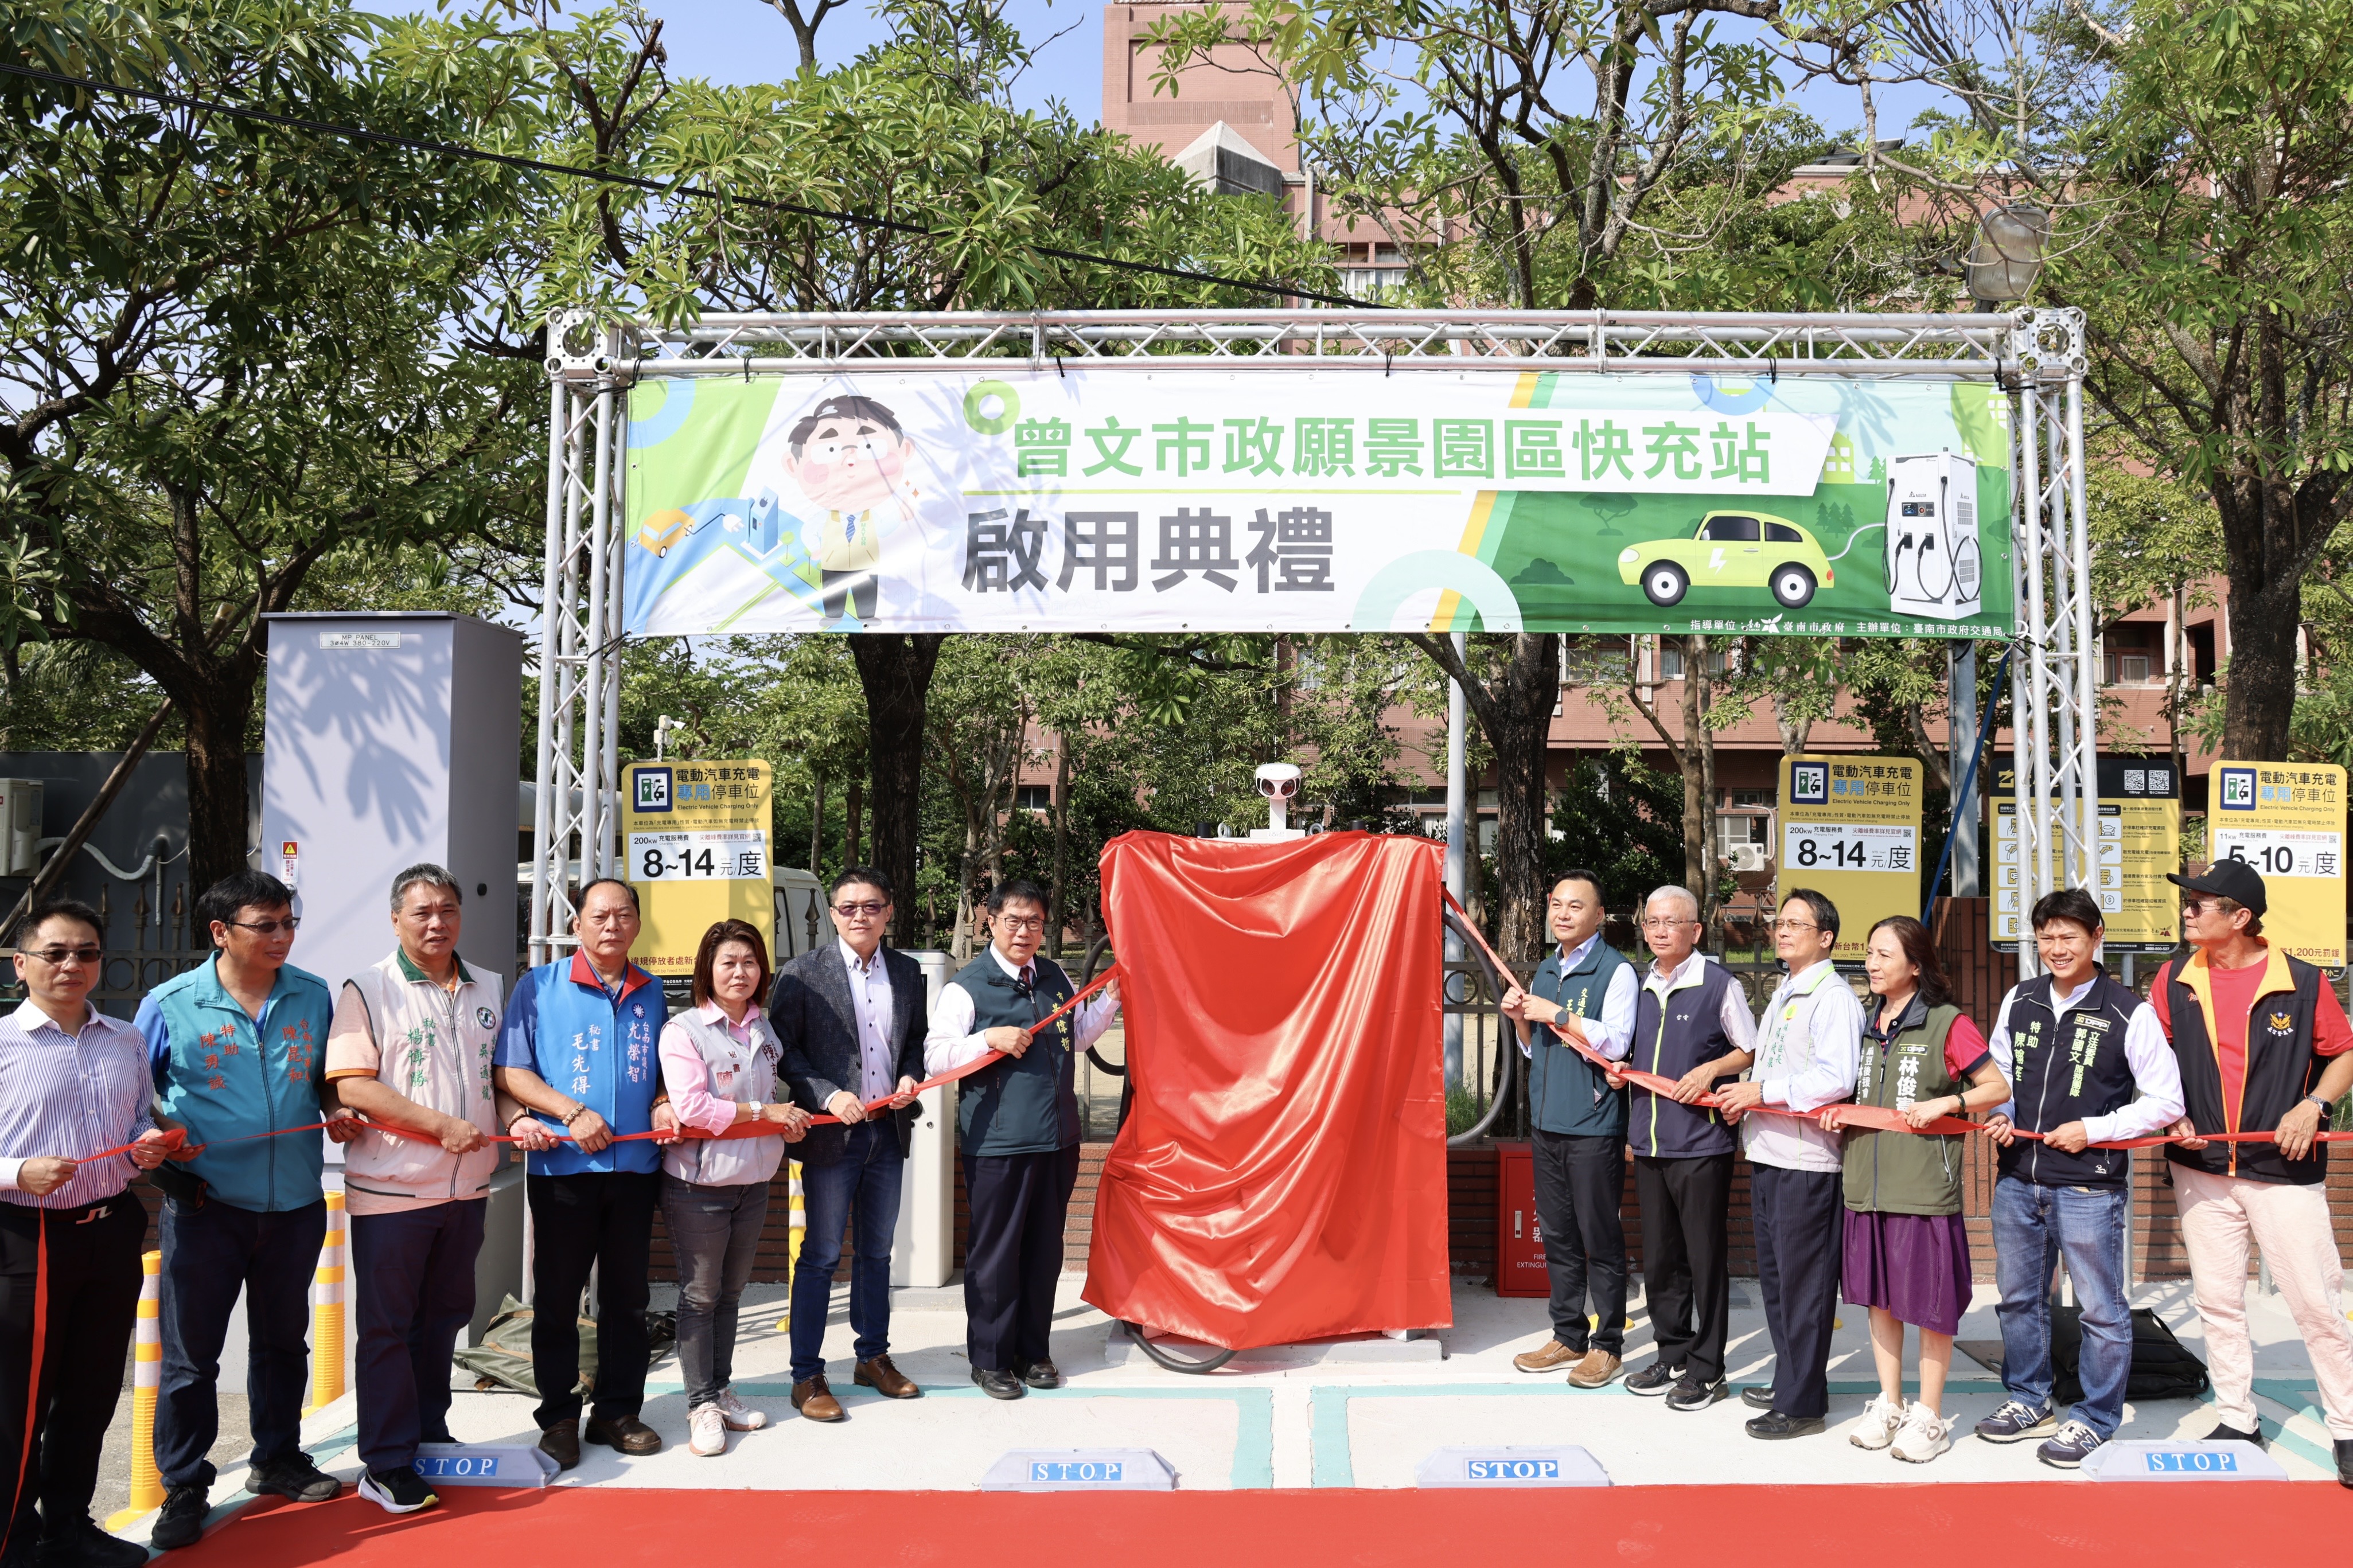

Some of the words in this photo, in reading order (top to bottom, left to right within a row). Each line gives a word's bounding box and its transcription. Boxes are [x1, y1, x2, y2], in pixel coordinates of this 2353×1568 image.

[1015, 416, 1771, 483] 曾文市政願景園區快充站
[961, 507, 1333, 594] 啟用典禮
[676, 767, 759, 782] 電動汽車充電
[1832, 765, 1912, 779] 電動汽車充電
[2260, 771, 2336, 786] 電動汽車充電
[676, 783, 759, 801] 專用停車位
[1832, 779, 1911, 797] 專用停車位
[2260, 785, 2336, 803] 專用停車位
[643, 848, 715, 877] 8~14
[1798, 839, 1866, 868] 8~14
[2229, 845, 2293, 873] 5~10
[1576, 988, 1588, 1017] 交通局
[2026, 1021, 2041, 1048] 特助
[2085, 1017, 2108, 1028] DPP
[220, 1023, 239, 1056] 特助
[589, 1024, 601, 1051] 秘書
[641, 1021, 650, 1081] 台南市議員
[2068, 1028, 2087, 1063] 郭國文
[2083, 1031, 2100, 1067] 立法委員
[200, 1032, 226, 1090] 陳勇誠
[281, 1024, 303, 1083] 陳昆和
[408, 1028, 427, 1087] 楊博勝
[571, 1033, 591, 1095] 毛先得
[627, 1022, 641, 1083] 尤榮智
[727, 1051, 741, 1072] 秘書
[415, 1458, 493, 1475] STOP
[1037, 1463, 1117, 1480] STOP
[1471, 1461, 1556, 1478] STOP
[2152, 1453, 2230, 1471] STOP
